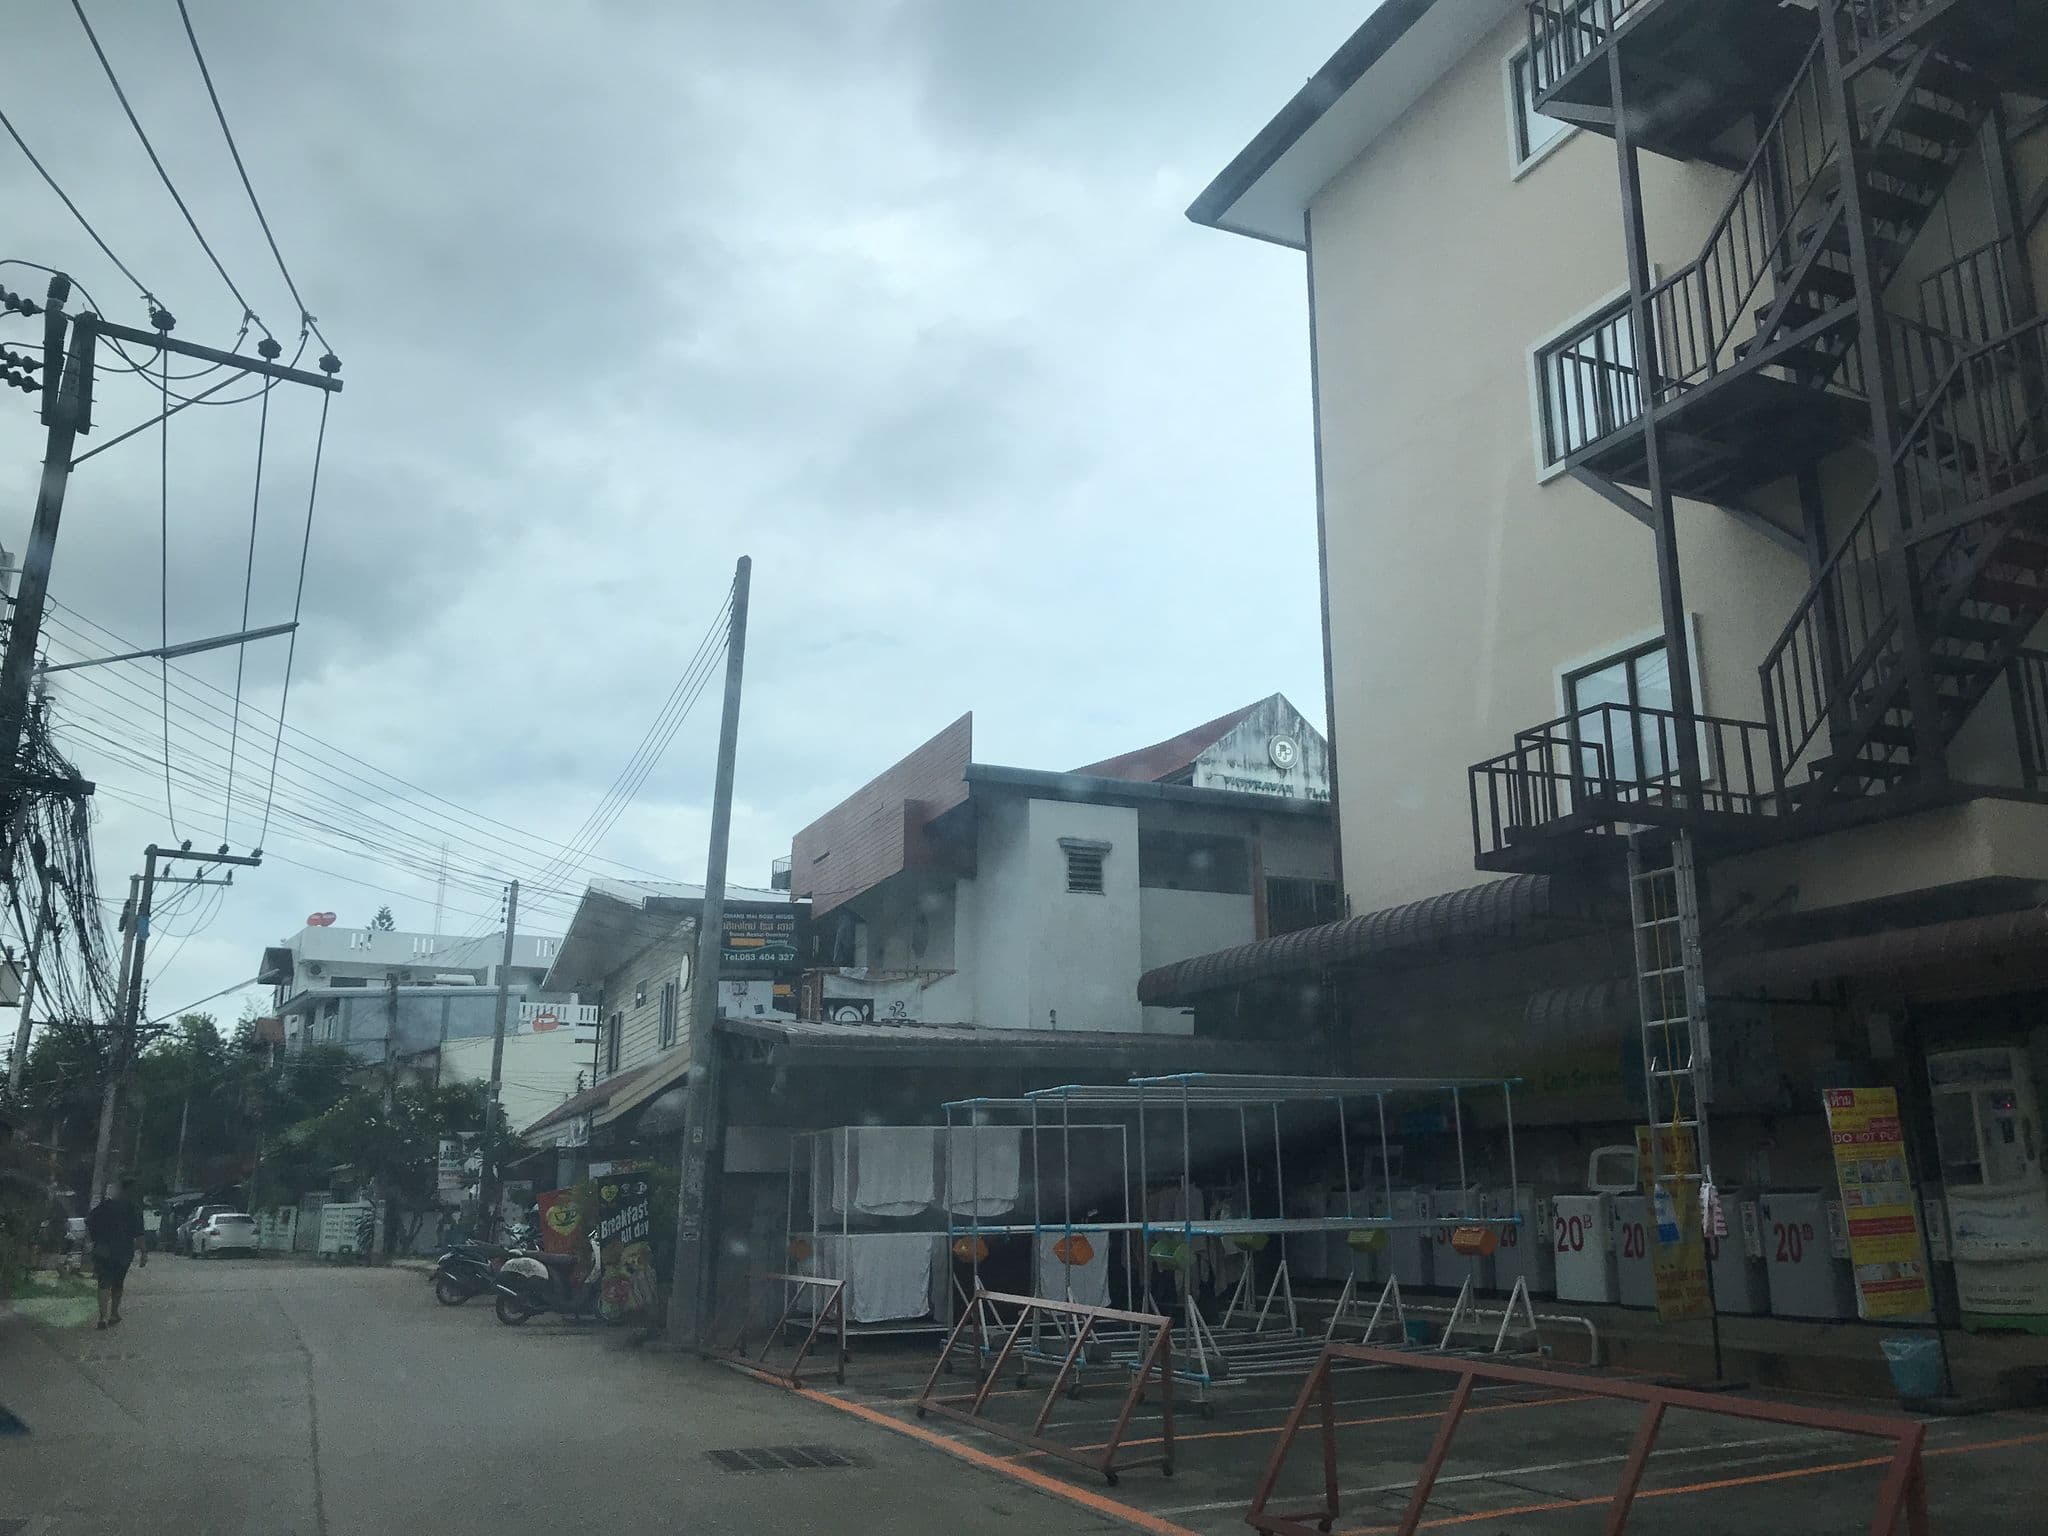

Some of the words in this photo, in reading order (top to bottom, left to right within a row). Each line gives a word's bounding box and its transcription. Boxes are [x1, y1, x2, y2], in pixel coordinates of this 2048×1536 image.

[759, 953, 775, 961] 404
[778, 953, 795, 961] 327
[1834, 1133, 1853, 1143] DO
[601, 1198, 649, 1239] Breakfast
[621, 1226, 632, 1243] All
[634, 1220, 649, 1238] day
[1622, 1222, 1645, 1258] 20
